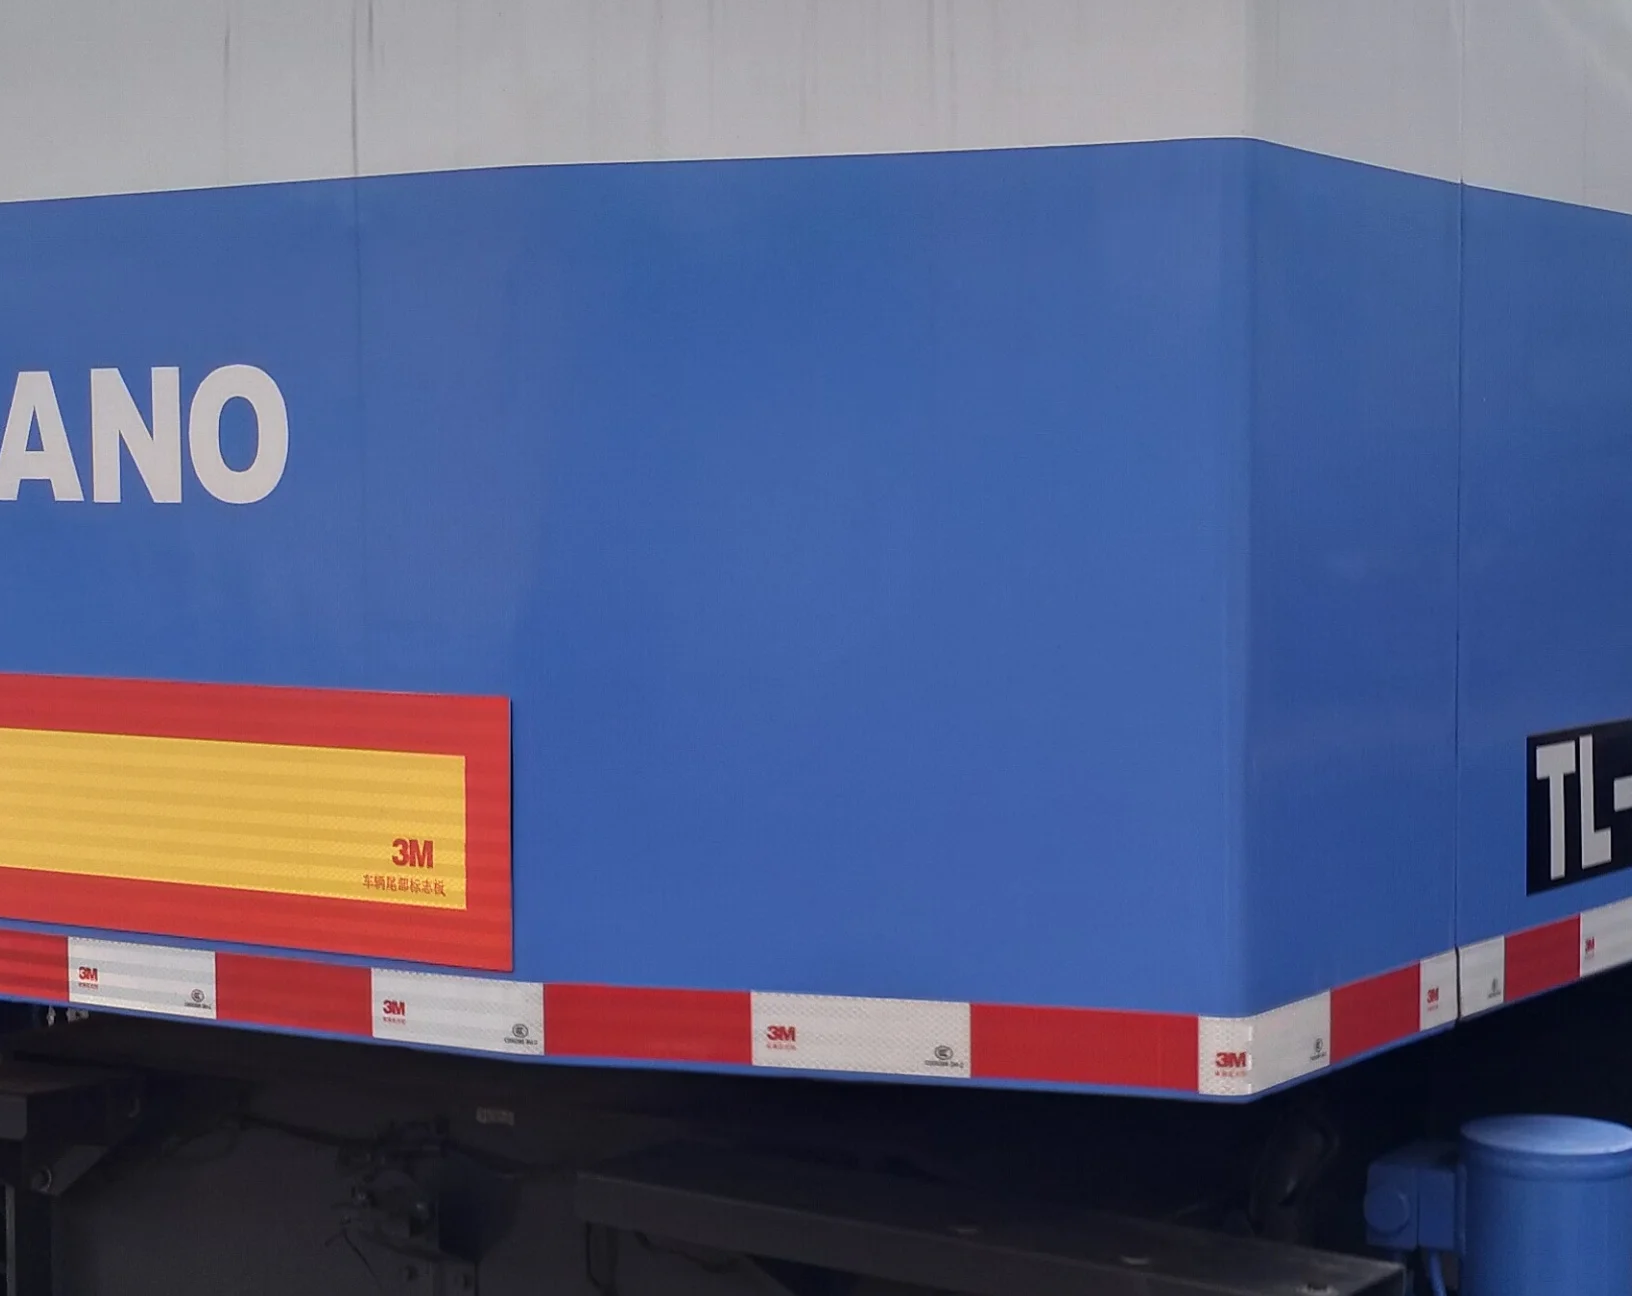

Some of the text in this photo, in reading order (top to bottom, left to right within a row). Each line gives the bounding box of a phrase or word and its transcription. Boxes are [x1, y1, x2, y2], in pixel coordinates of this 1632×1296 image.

[391, 838, 434, 869] 3M
[363, 874, 447, 897] 车辆尾部标志板
[78, 966, 98, 982] 3M
[382, 999, 406, 1016] 3M
[766, 1025, 796, 1042] 3M
[1215, 1051, 1247, 1068] 3M
